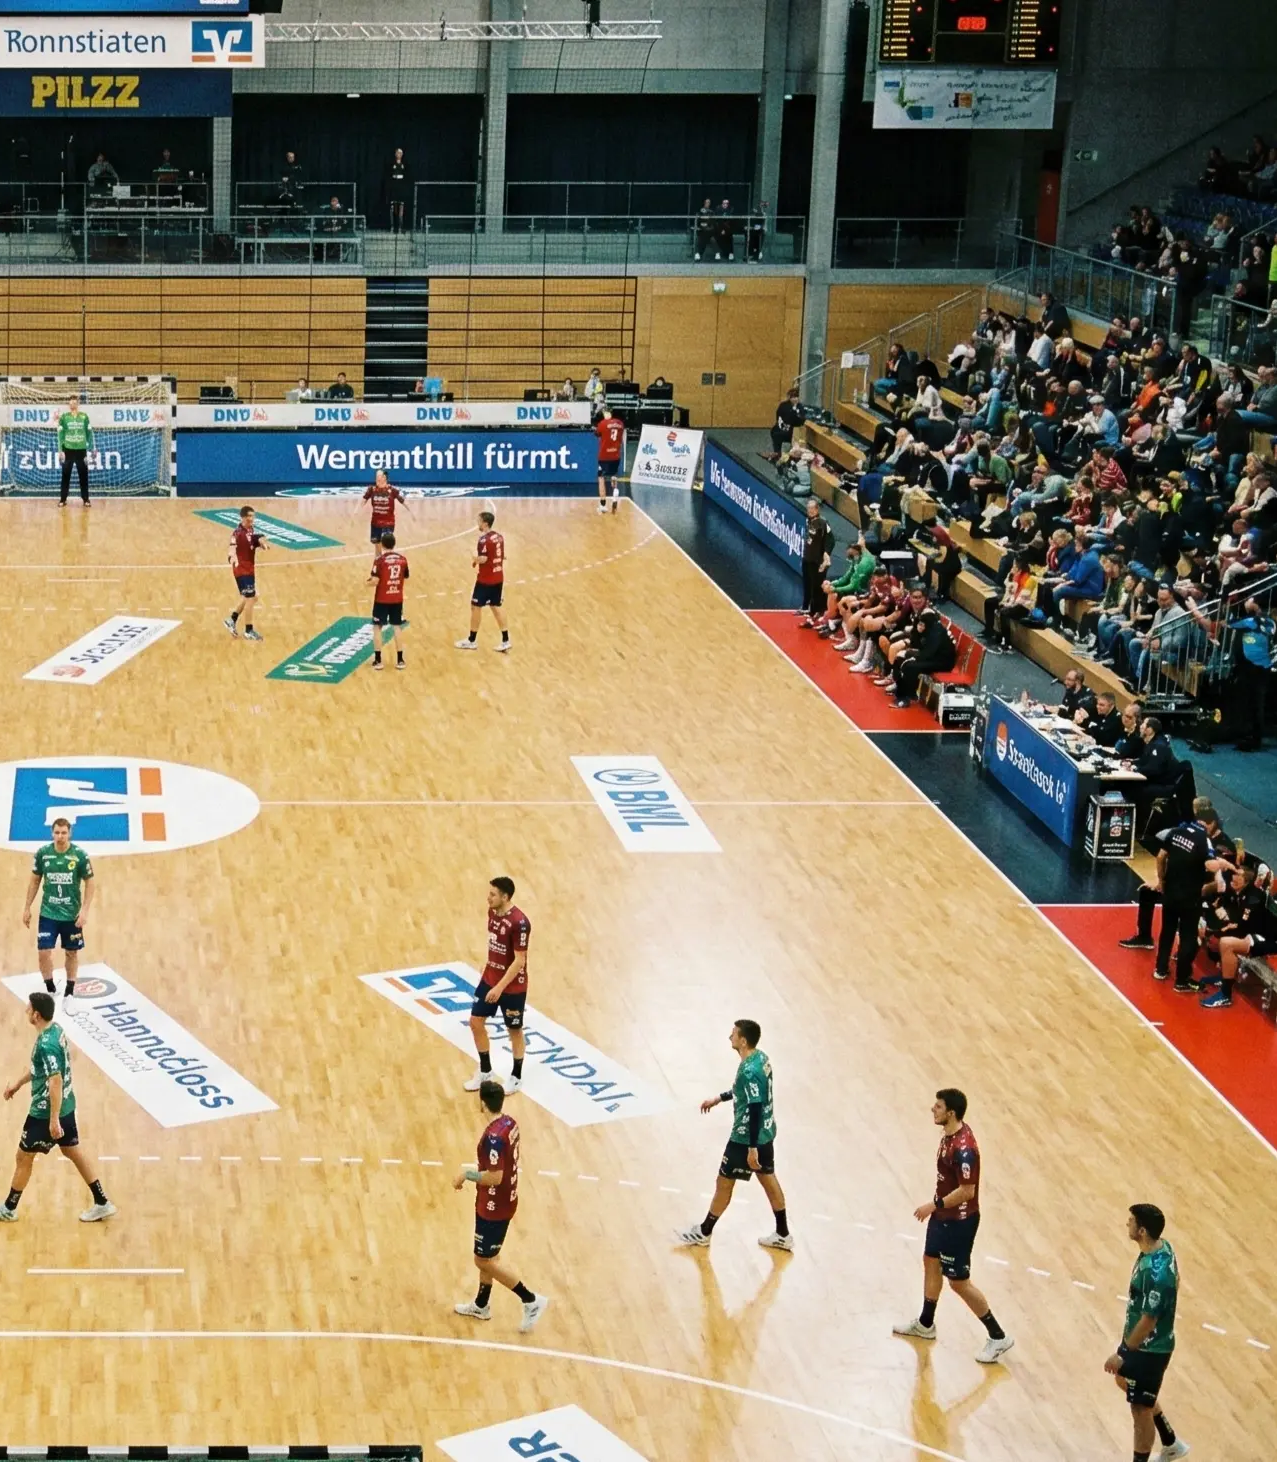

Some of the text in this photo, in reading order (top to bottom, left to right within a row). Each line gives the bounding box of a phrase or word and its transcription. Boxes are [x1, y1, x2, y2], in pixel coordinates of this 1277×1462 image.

[3, 29, 166, 54] Ronnstiaten
[30, 75, 141, 108] PILZZ
[483, 442, 579, 470] fürmt.
[606, 790, 690, 833] BML
